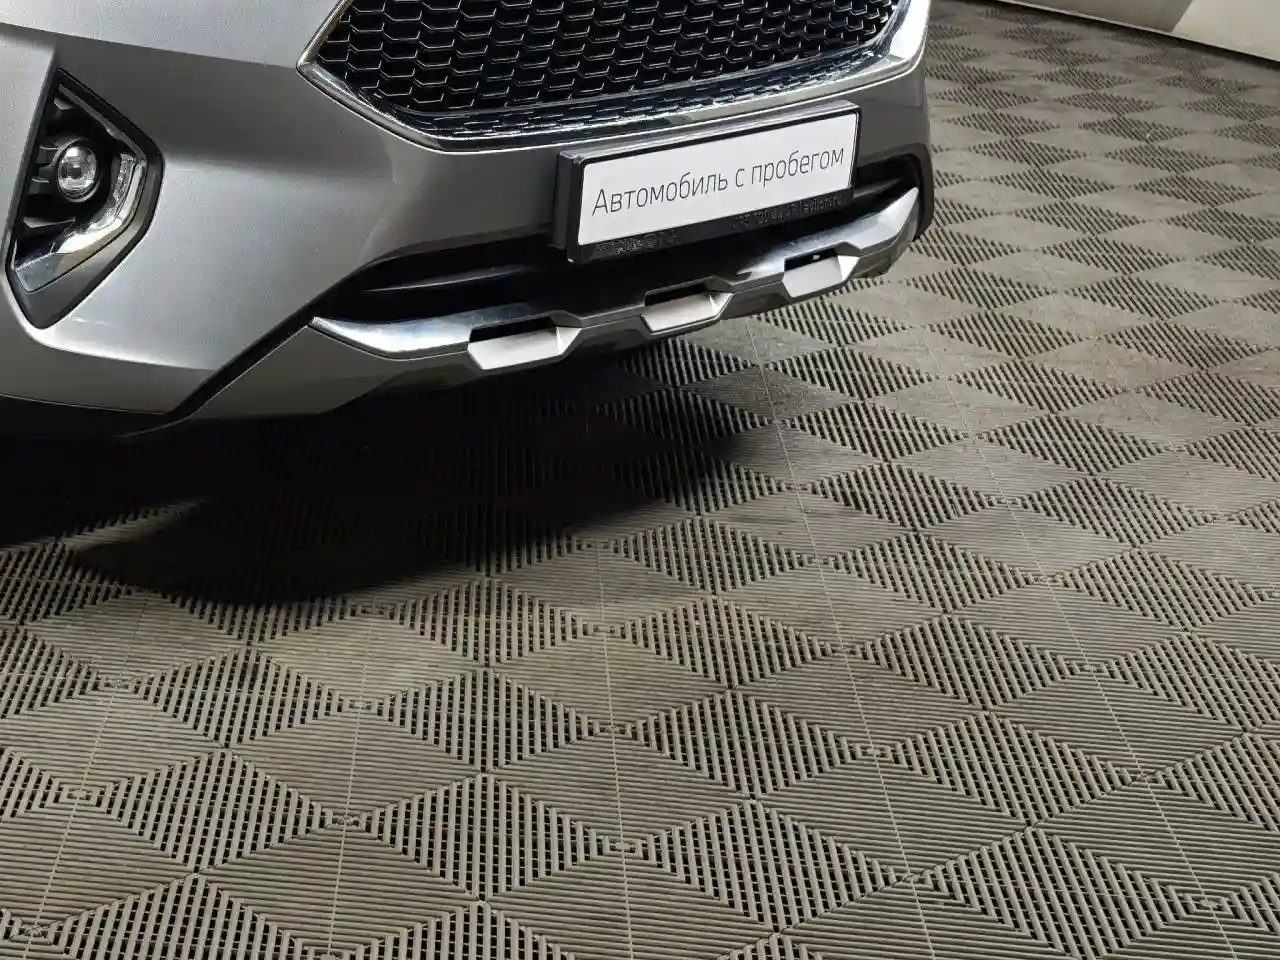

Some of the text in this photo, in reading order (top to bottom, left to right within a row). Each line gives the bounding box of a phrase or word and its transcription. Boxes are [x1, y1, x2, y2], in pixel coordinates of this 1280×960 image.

[591, 171, 729, 217] Автомобиль
[735, 167, 745, 189] с
[751, 146, 845, 189] пробегом
